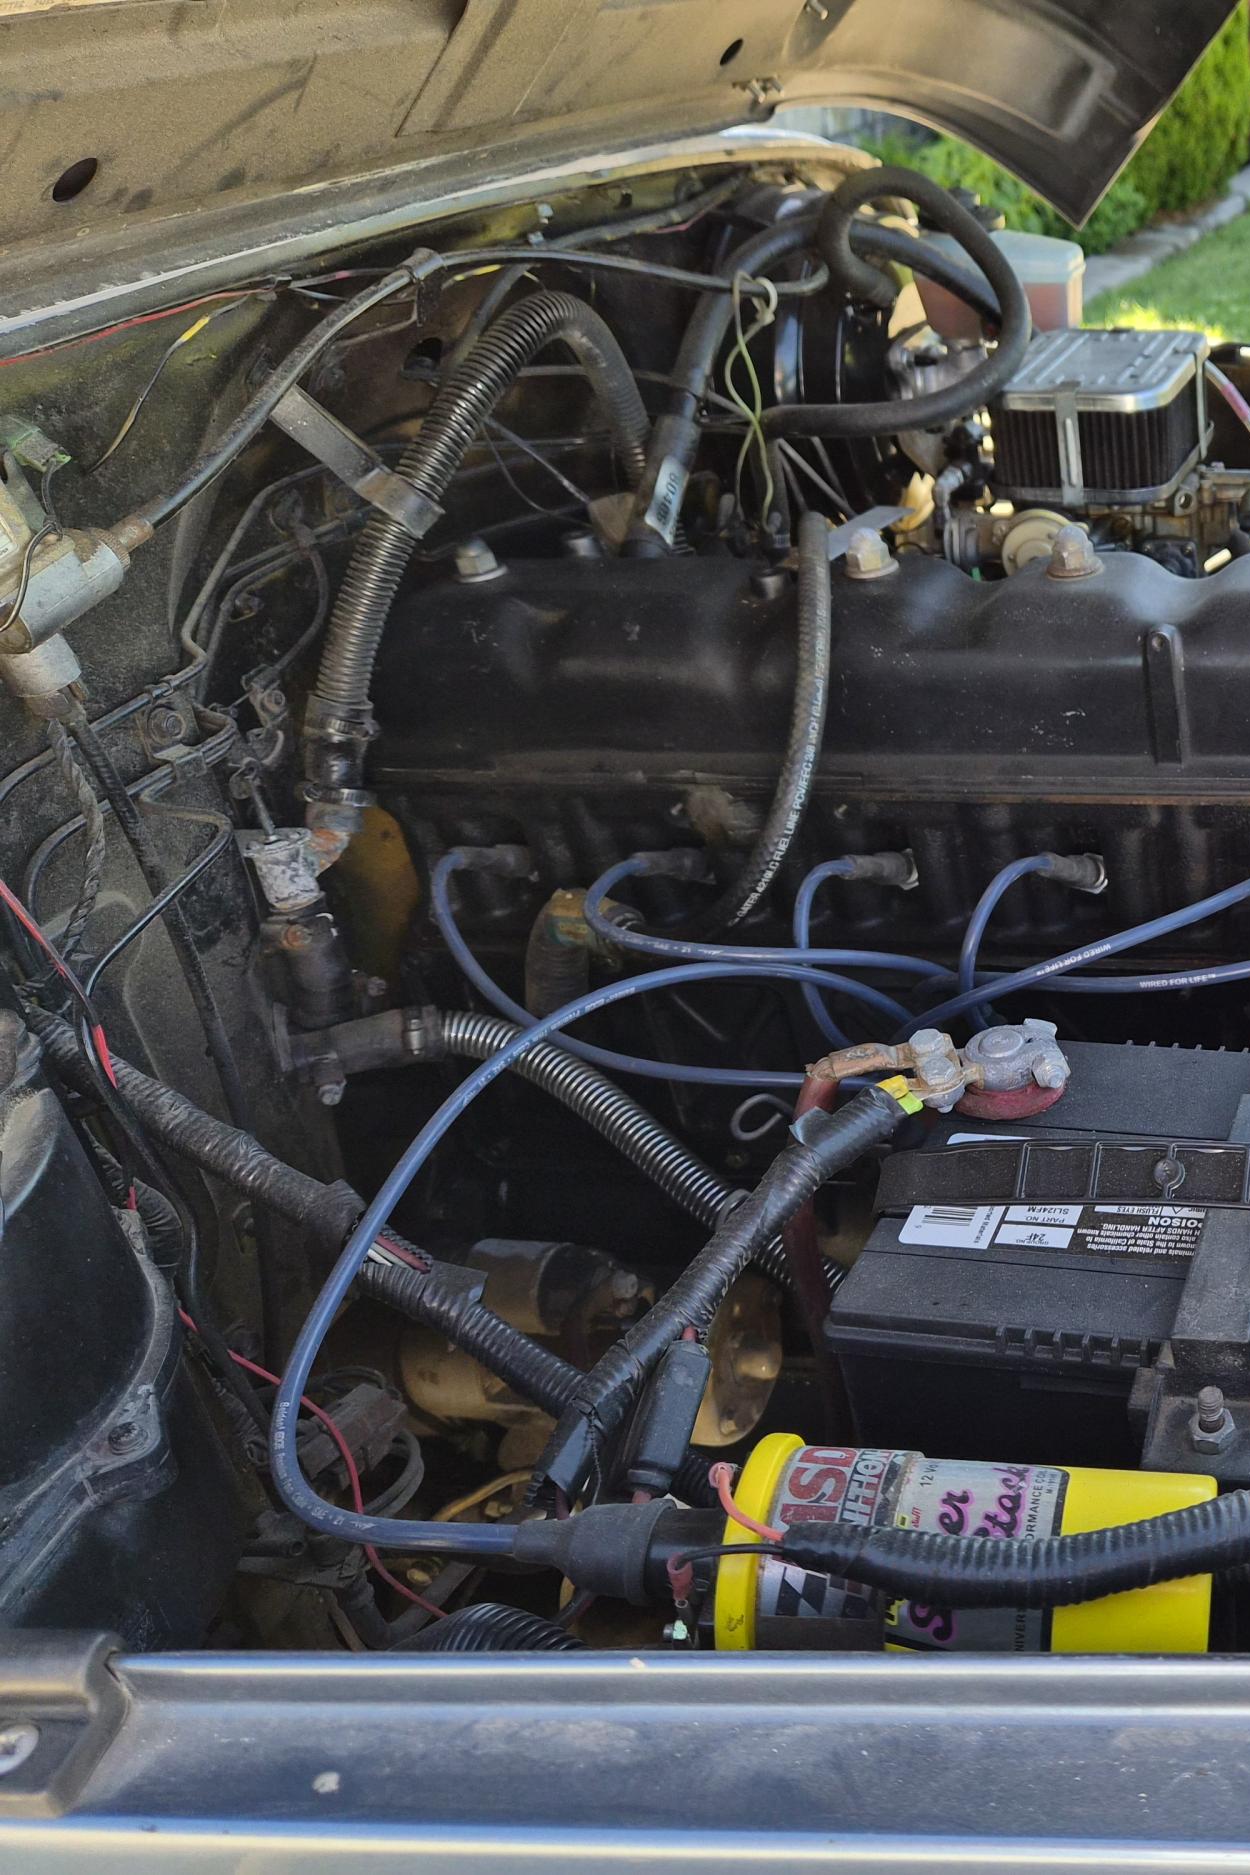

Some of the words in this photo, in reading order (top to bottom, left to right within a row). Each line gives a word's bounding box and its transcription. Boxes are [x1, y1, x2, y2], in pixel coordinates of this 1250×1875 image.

[1083, 944, 1111, 958] WIRED
[1064, 954, 1082, 965] FOR
[1139, 980, 1168, 988] WIRED
[1169, 978, 1188, 986] FOR
[1025, 1232, 1046, 1241] 24F
[1100, 1230, 1135, 1238] chemicals
[1155, 1233, 1180, 1241] contain
[1094, 1237, 1127, 1245] California
[1136, 1239, 1154, 1247] State
[1155, 1240, 1166, 1248] the
[1087, 1243, 1127, 1251] accessories
[1168, 1248, 1196, 1256] rminals
[920, 1475, 934, 1487] 12
[841, 1449, 893, 1526] NITION
[1025, 1485, 1044, 1540] ORMANCE
